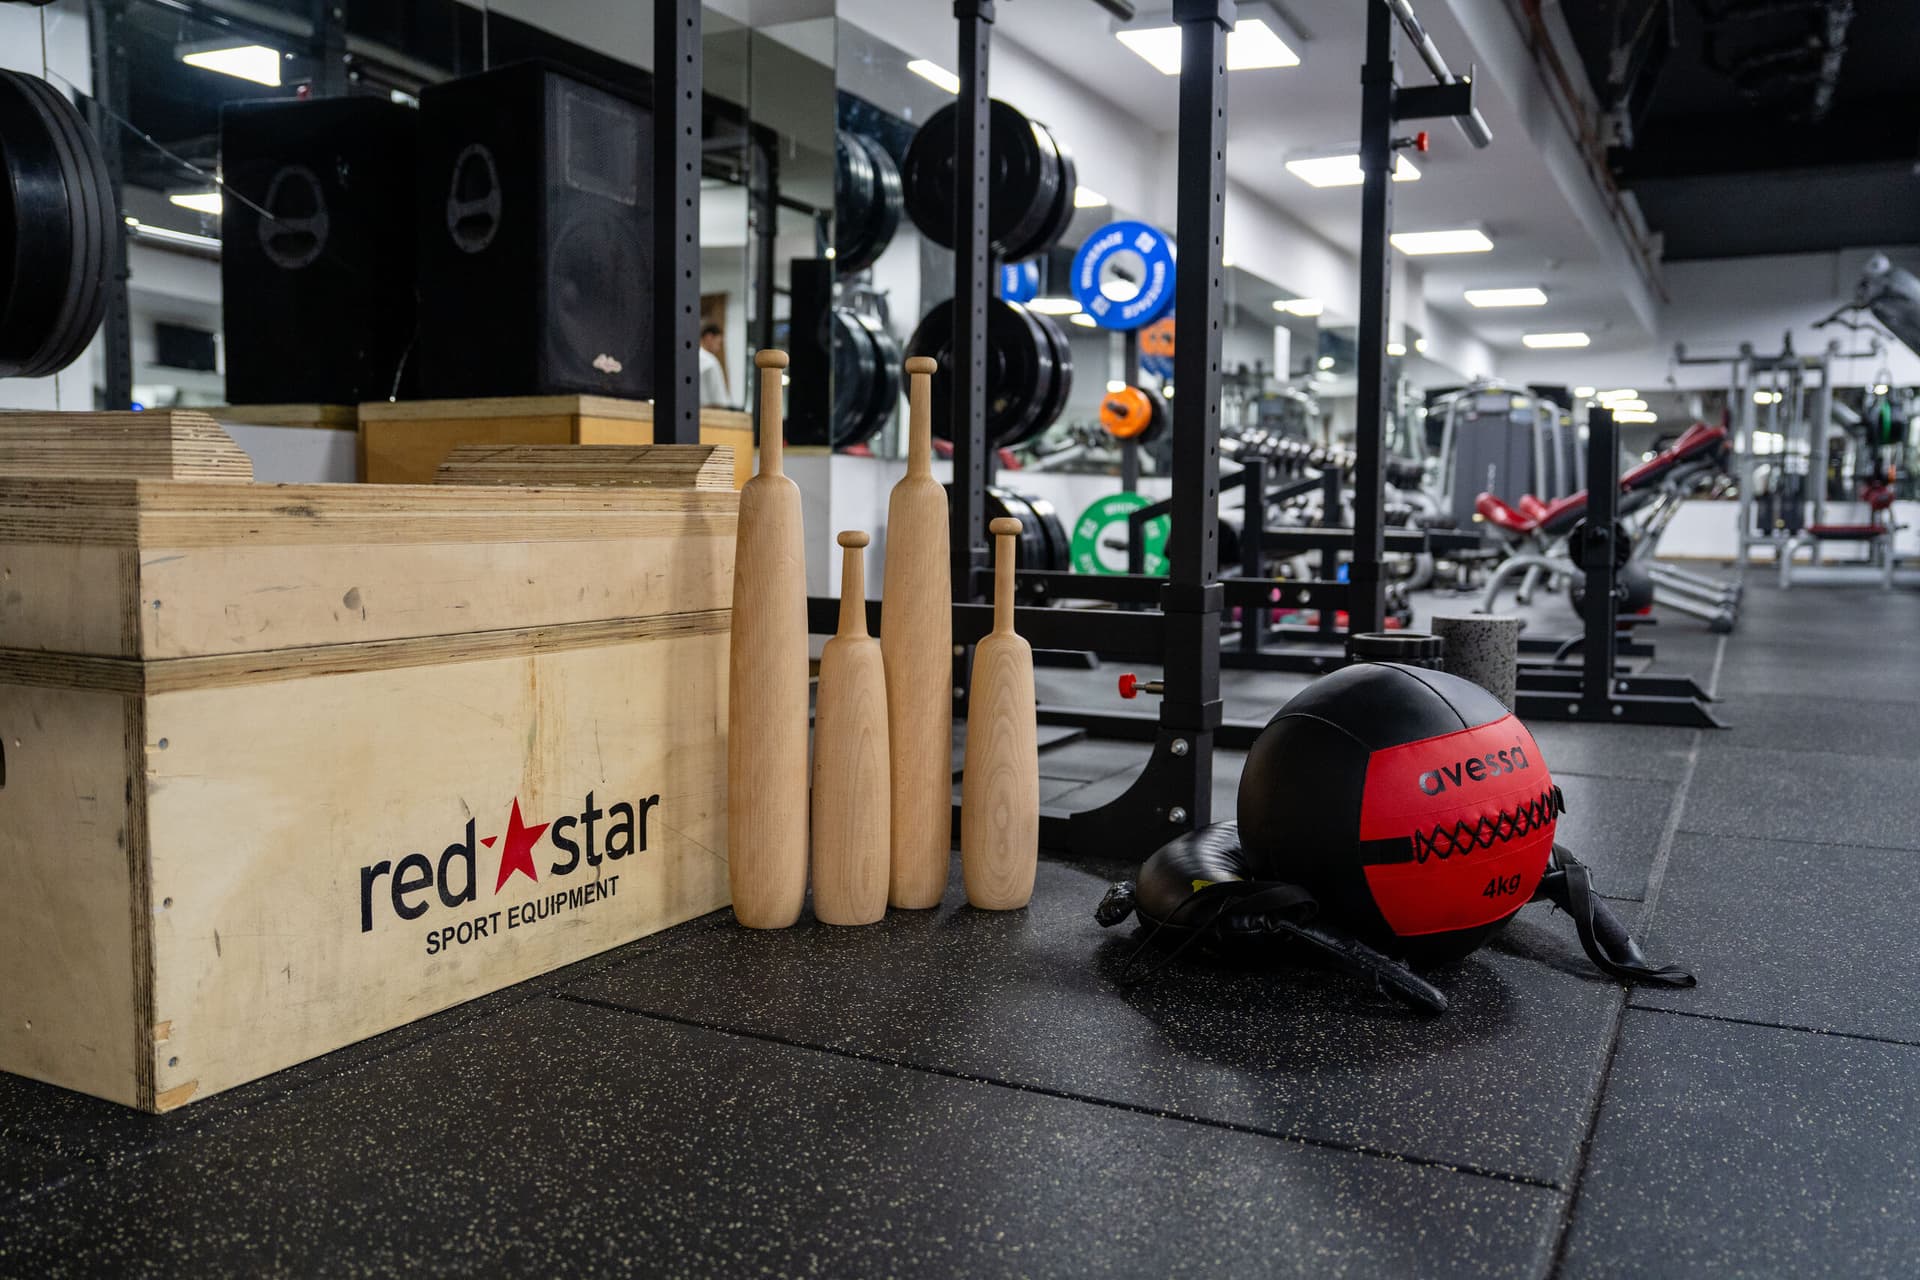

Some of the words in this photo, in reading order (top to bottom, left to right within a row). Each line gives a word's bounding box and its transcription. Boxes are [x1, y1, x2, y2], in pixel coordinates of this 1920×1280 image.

[1418, 746, 1529, 796] avessa
[360, 816, 477, 933] red
[550, 789, 661, 876] star
[1482, 873, 1521, 899] 4kg
[425, 911, 502, 956] SPORT
[507, 875, 620, 930] EQUIPMENT
